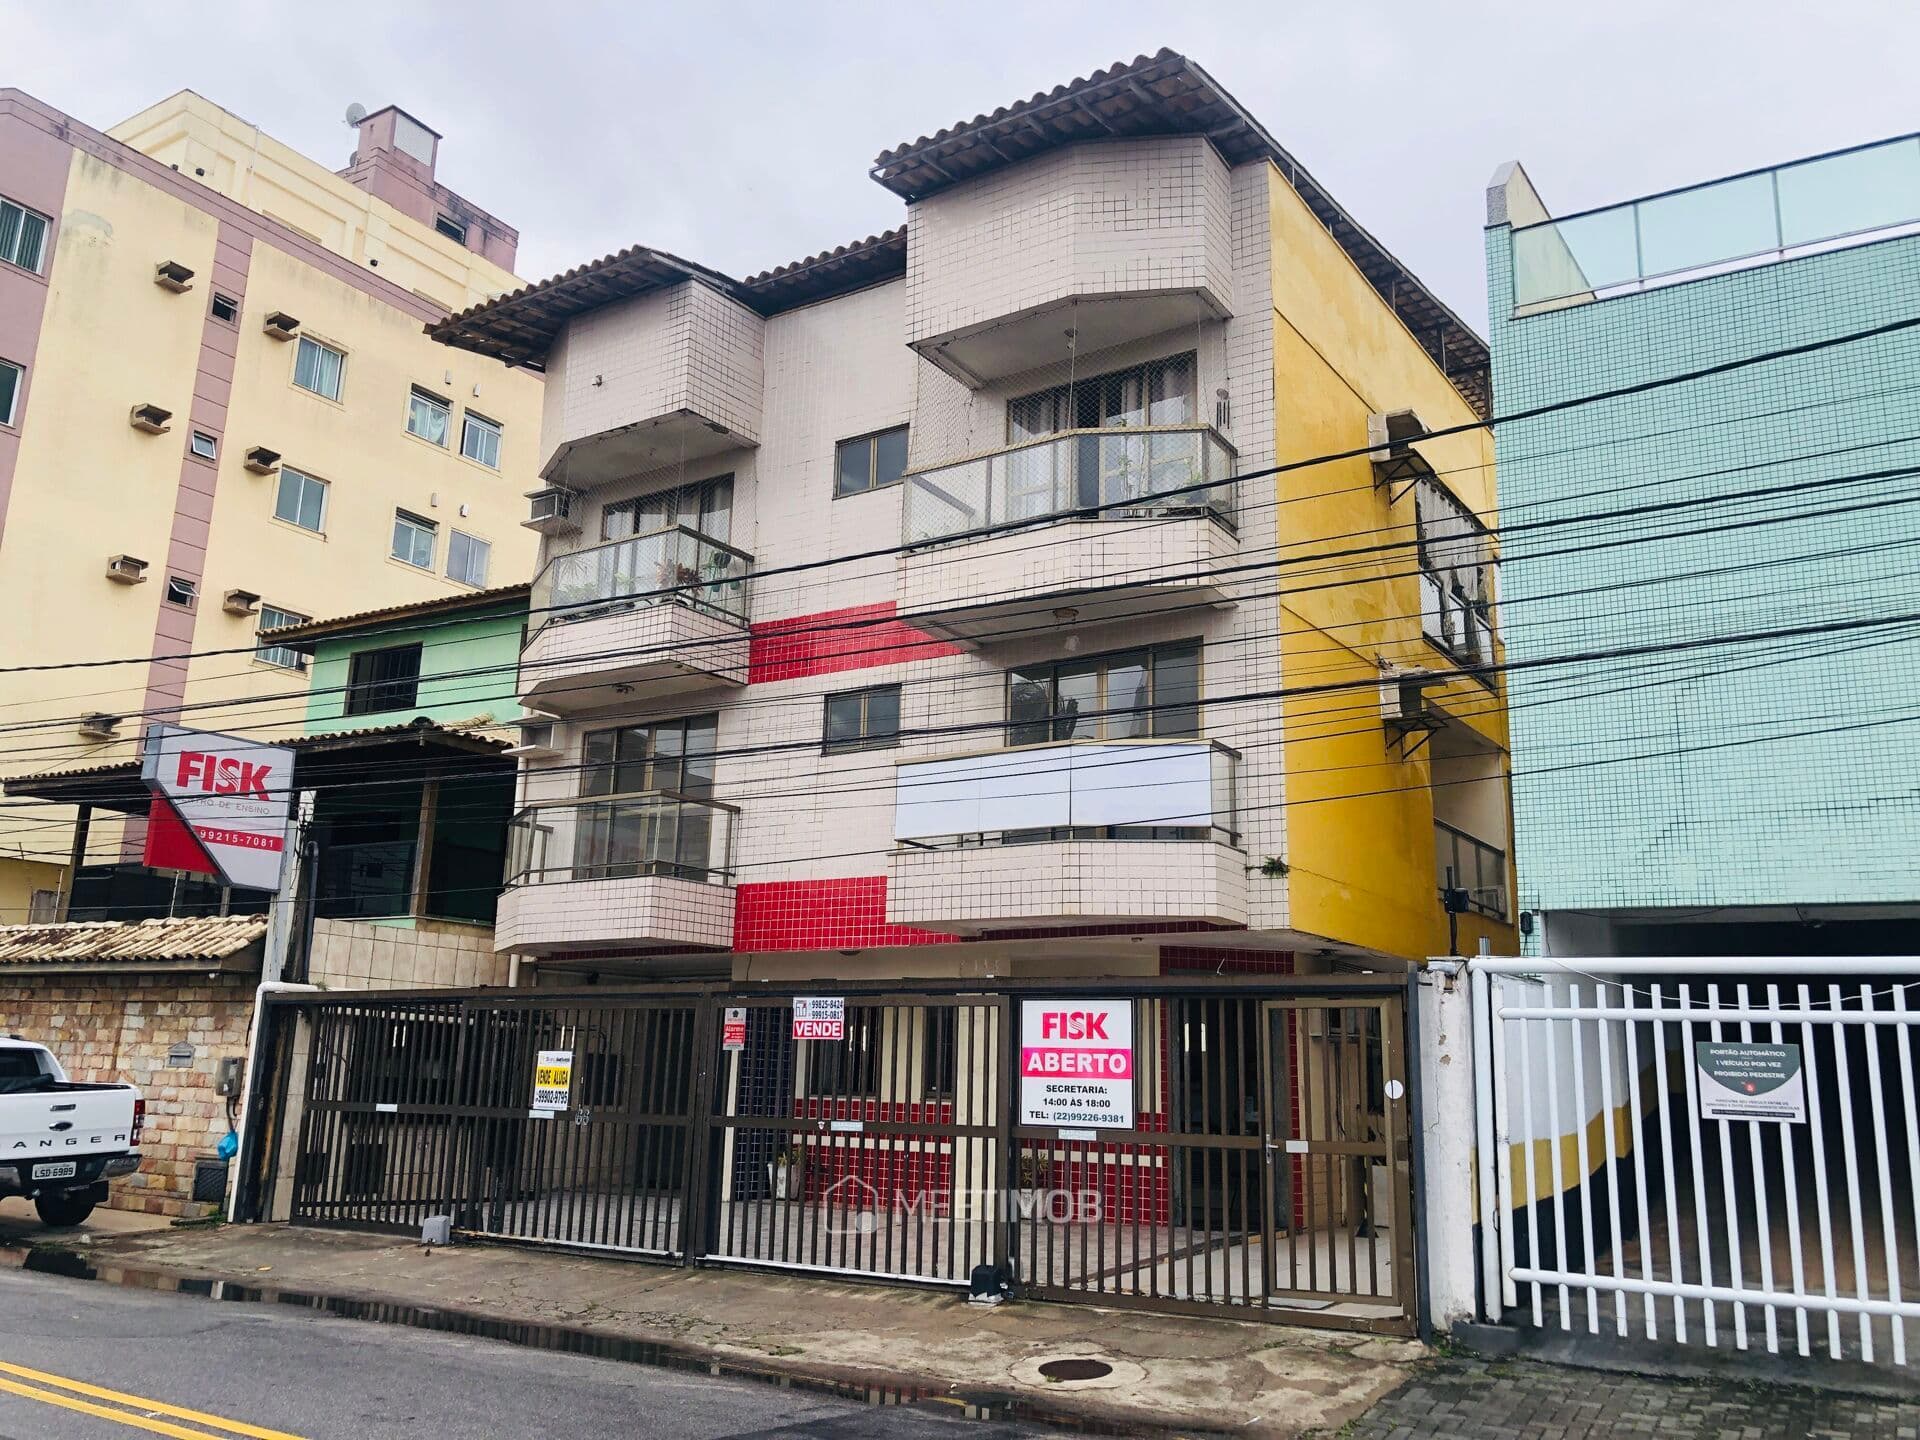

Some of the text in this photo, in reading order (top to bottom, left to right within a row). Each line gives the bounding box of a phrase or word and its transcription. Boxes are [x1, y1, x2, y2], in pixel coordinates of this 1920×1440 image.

[177, 750, 273, 802] FISK
[218, 800, 231, 809] DE
[236, 803, 271, 815] ENSINO
[200, 829, 274, 848] 99215-7081
[811, 999, 843, 1009] 99825-8424
[795, 1021, 841, 1037] VENDE
[1042, 1011, 1109, 1040] FISK
[1027, 1052, 1127, 1074] ABERTO
[1720, 1059, 1750, 1067] VEÍCULO
[1749, 1071, 1786, 1079] PEDESTRE
[1046, 1085, 1108, 1095] SECRETARIA:
[1043, 1098, 1067, 1107] 14:00
[1085, 1099, 1111, 1108] 18:00
[1029, 1110, 1124, 1123] TEL: (22)99226-9381
[0, 1134, 126, 1149] ANGER
